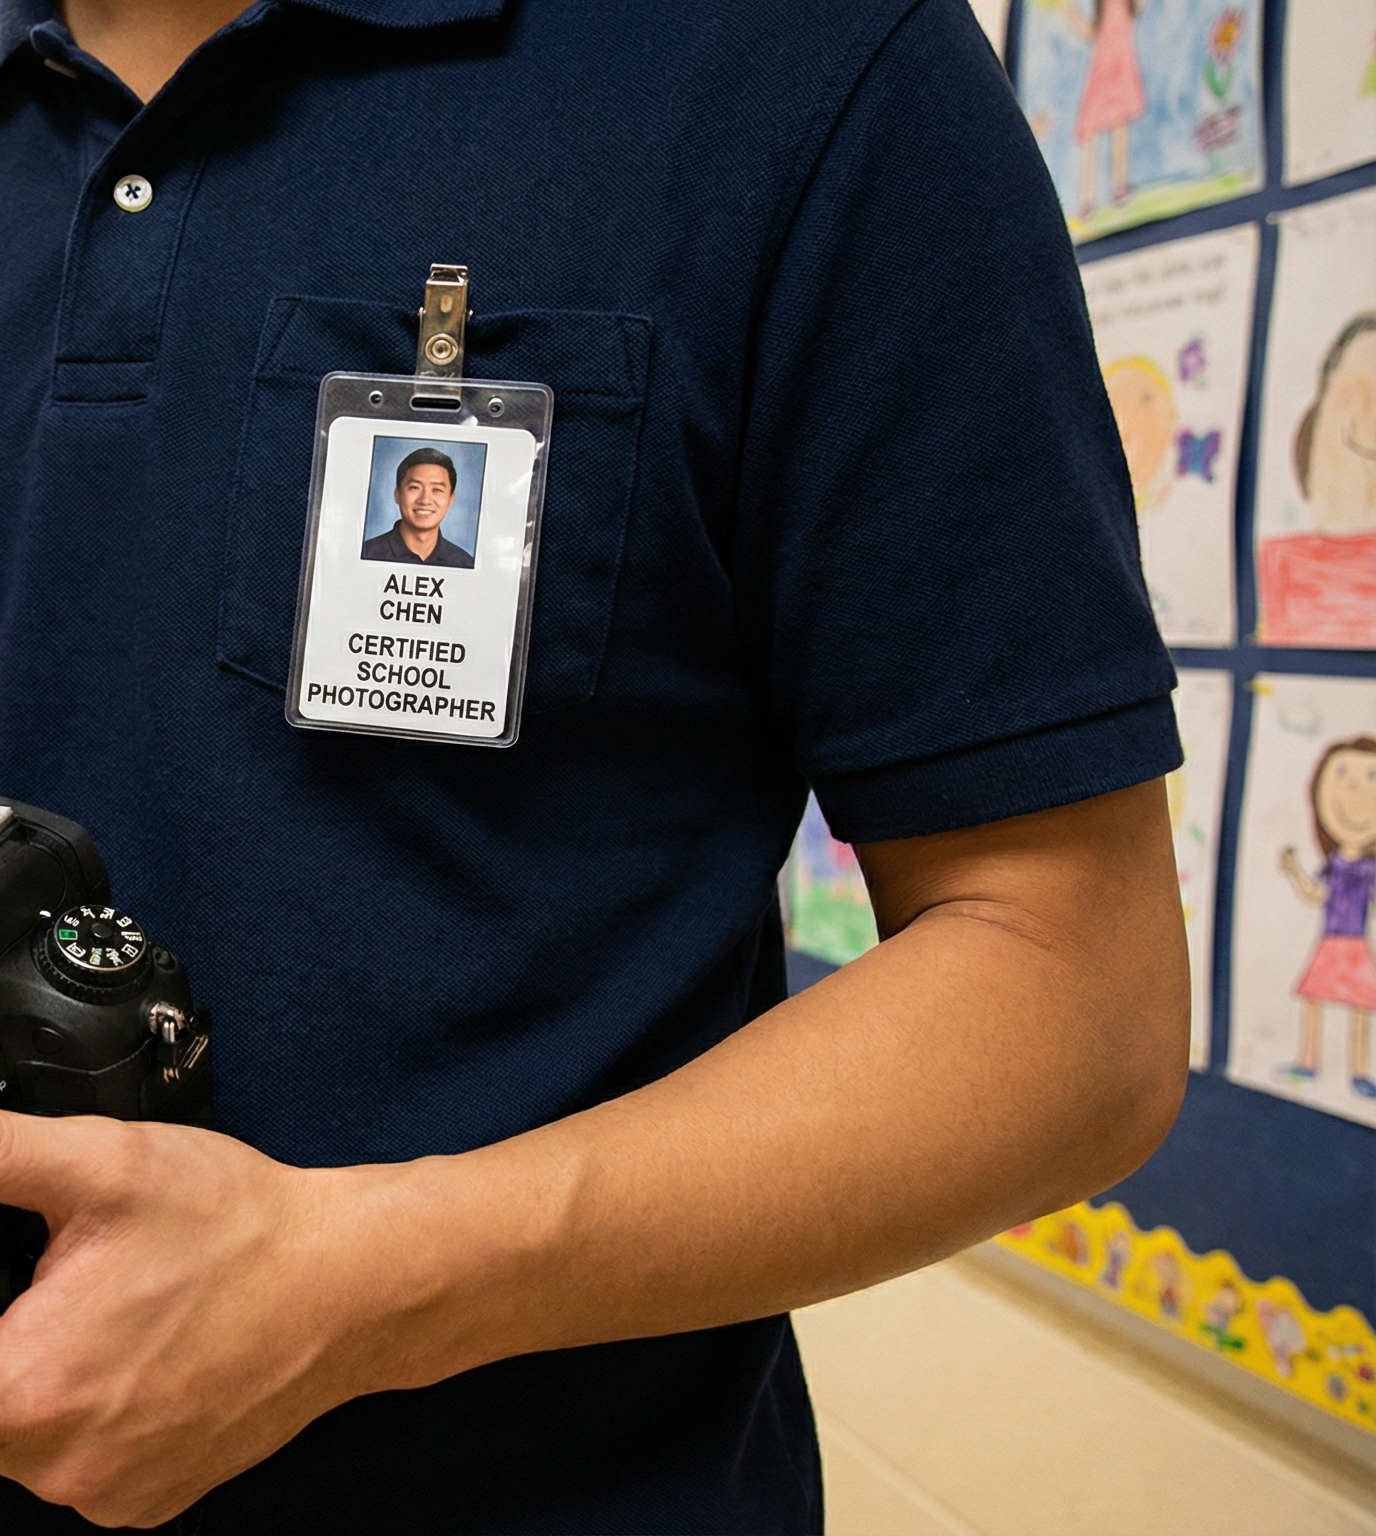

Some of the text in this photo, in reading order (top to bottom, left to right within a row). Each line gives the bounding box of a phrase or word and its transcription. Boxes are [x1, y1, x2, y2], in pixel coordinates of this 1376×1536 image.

[383, 573, 445, 598] ALEX
[379, 599, 443, 625] CHEN
[348, 633, 466, 664] CERTIFIED
[356, 661, 451, 690] SCHOOL
[307, 683, 496, 722] PHOTOGRAPHER
